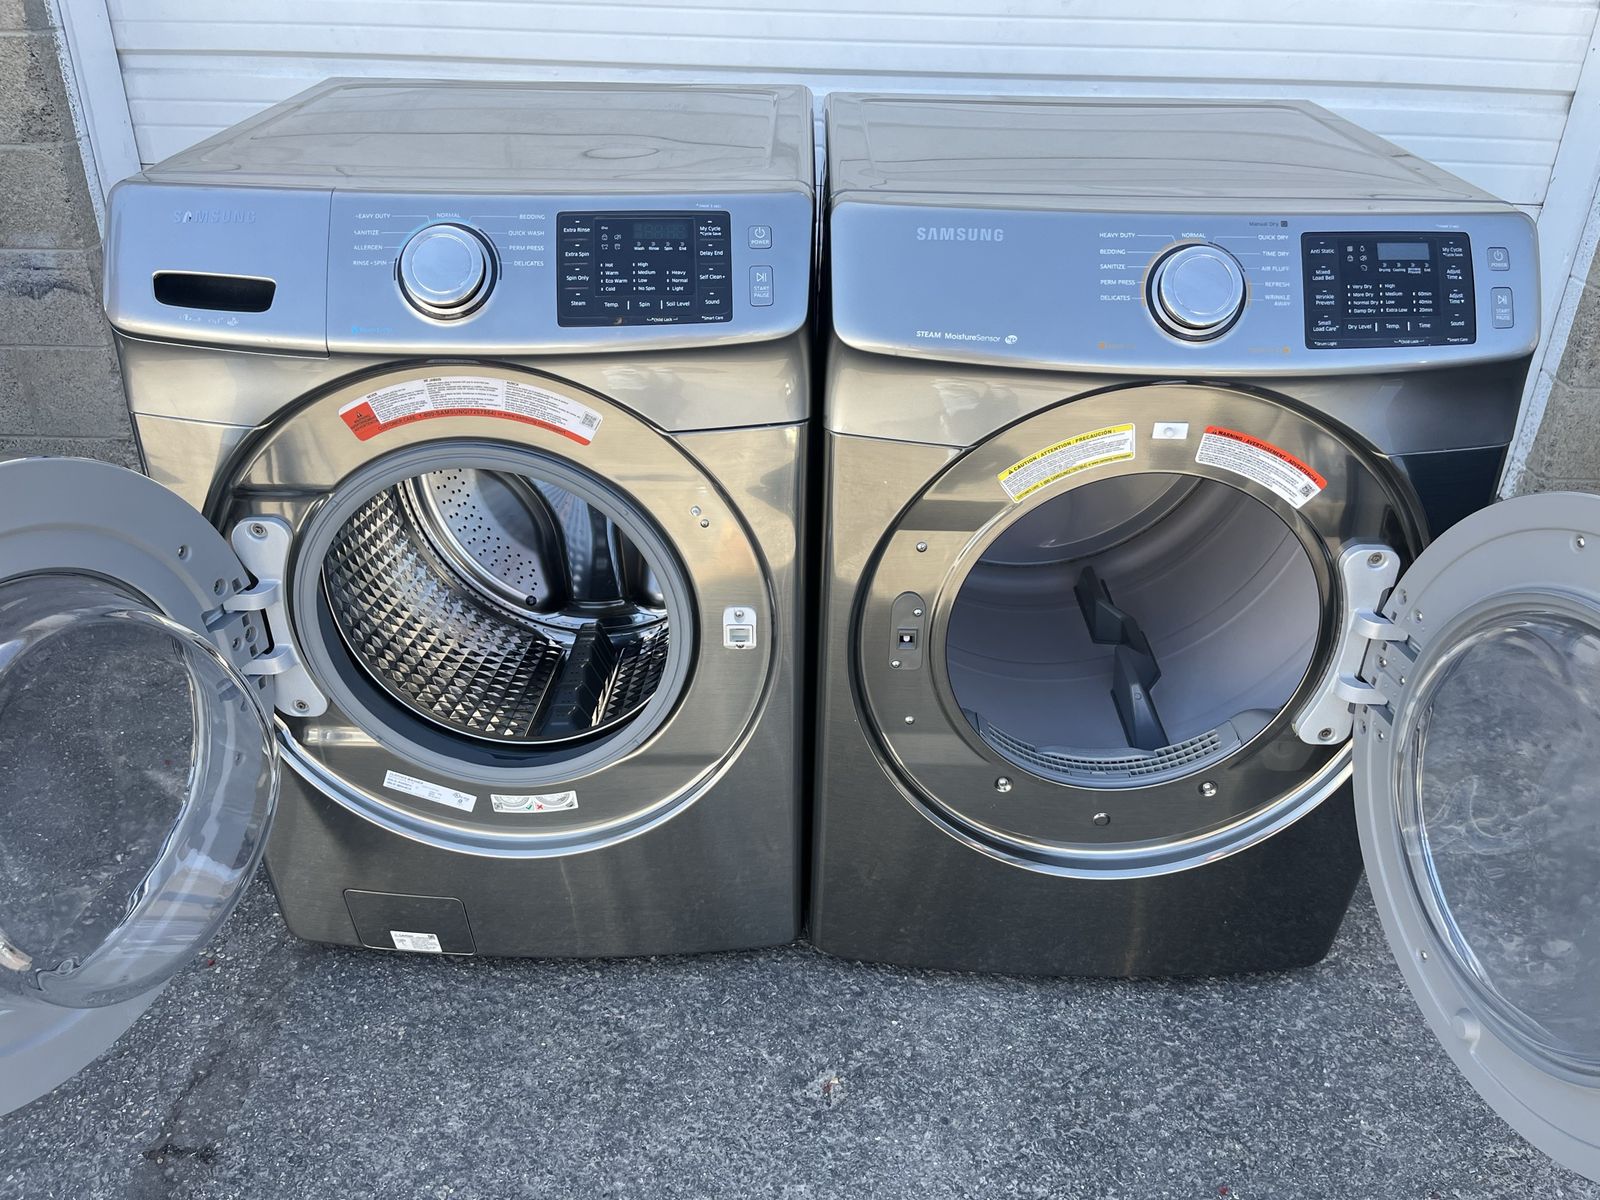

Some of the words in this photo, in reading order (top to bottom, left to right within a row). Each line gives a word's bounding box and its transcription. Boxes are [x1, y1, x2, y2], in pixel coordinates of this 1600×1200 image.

[917, 227, 1003, 241] SAMSUNG
[916, 331, 941, 339] STEAM
[945, 332, 1001, 342] MoistureSensor
[1219, 431, 1243, 440] WARNING
[1247, 439, 1285, 459] AVERTISSEMENT
[1013, 456, 1038, 472] CAUTION
[1040, 441, 1073, 457] ATTENTION
